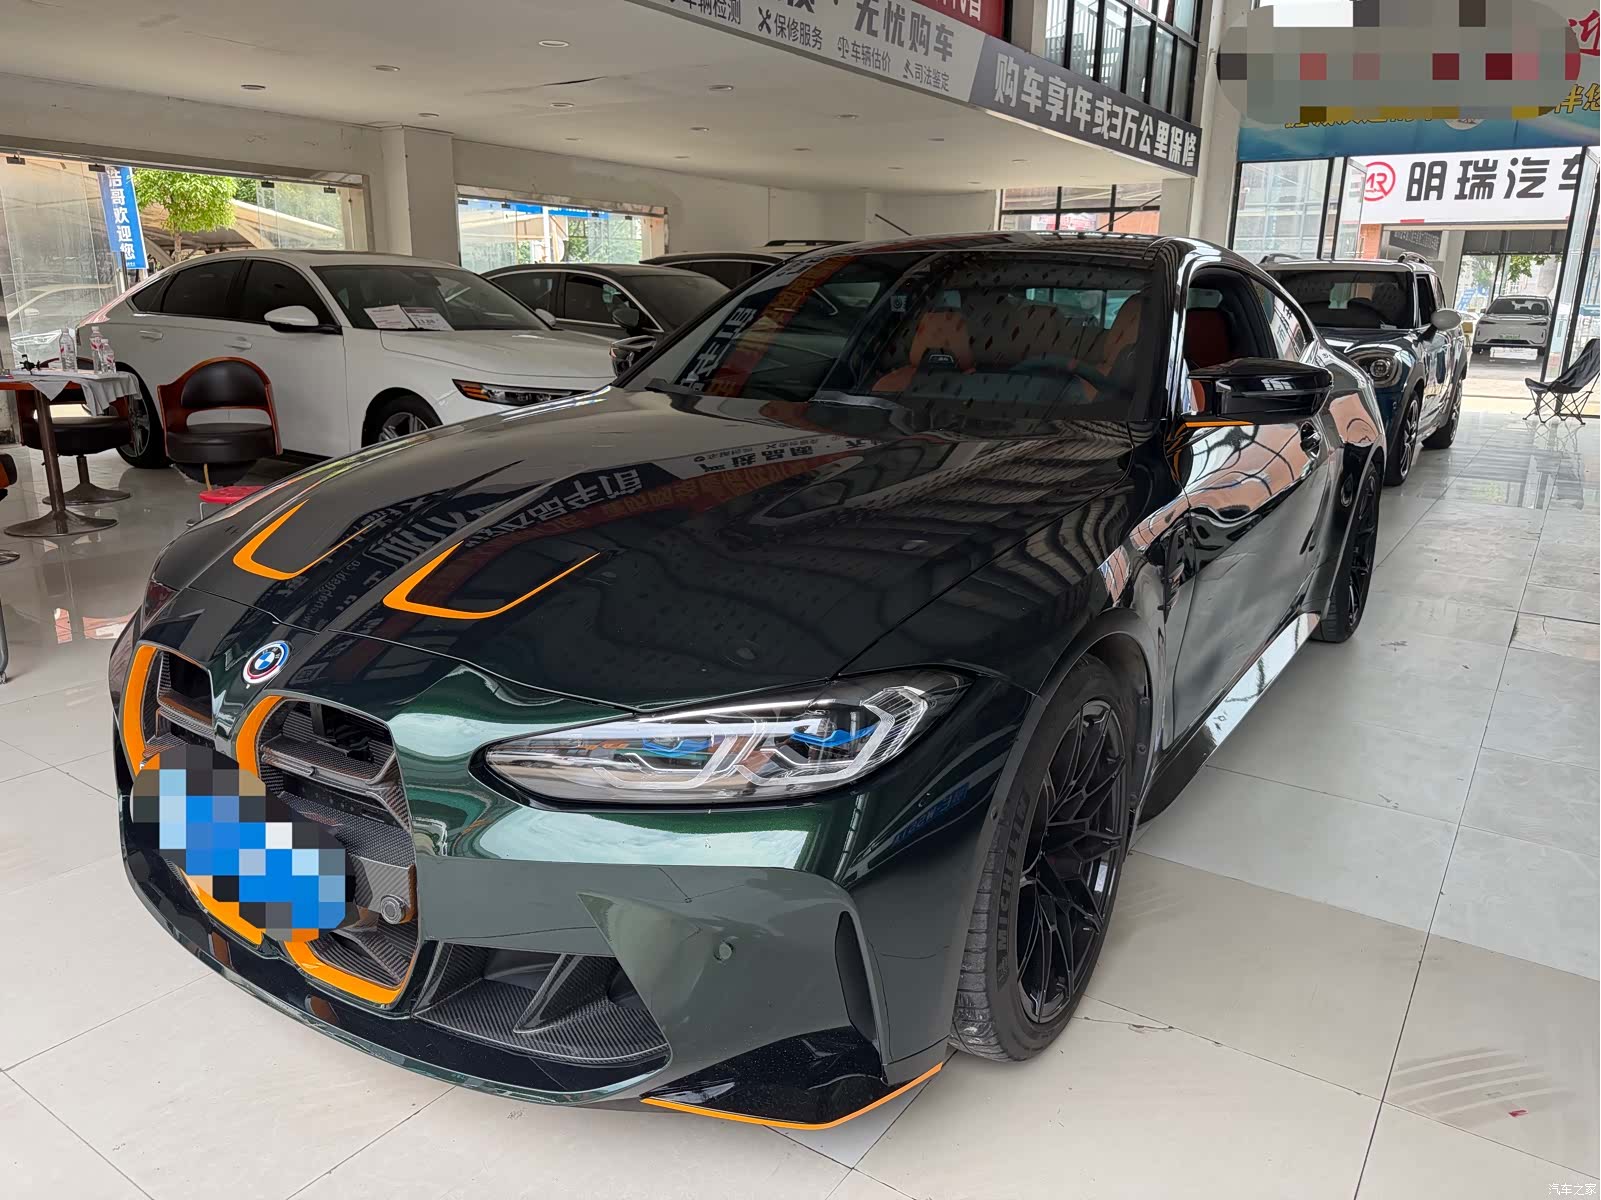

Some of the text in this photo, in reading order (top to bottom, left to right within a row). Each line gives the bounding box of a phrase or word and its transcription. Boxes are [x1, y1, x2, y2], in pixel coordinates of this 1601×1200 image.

[773, 12, 823, 51] 保修服务
[853, 0, 955, 62] 无忧购车
[850, 40, 892, 73] 车辆估价
[914, 63, 950, 93] 司法鉴定
[993, 52, 1197, 167] 购车享1年或3万公里保修
[1406, 153, 1580, 201] 明瑞汽车
[997, 791, 1031, 952] MICHELIN
